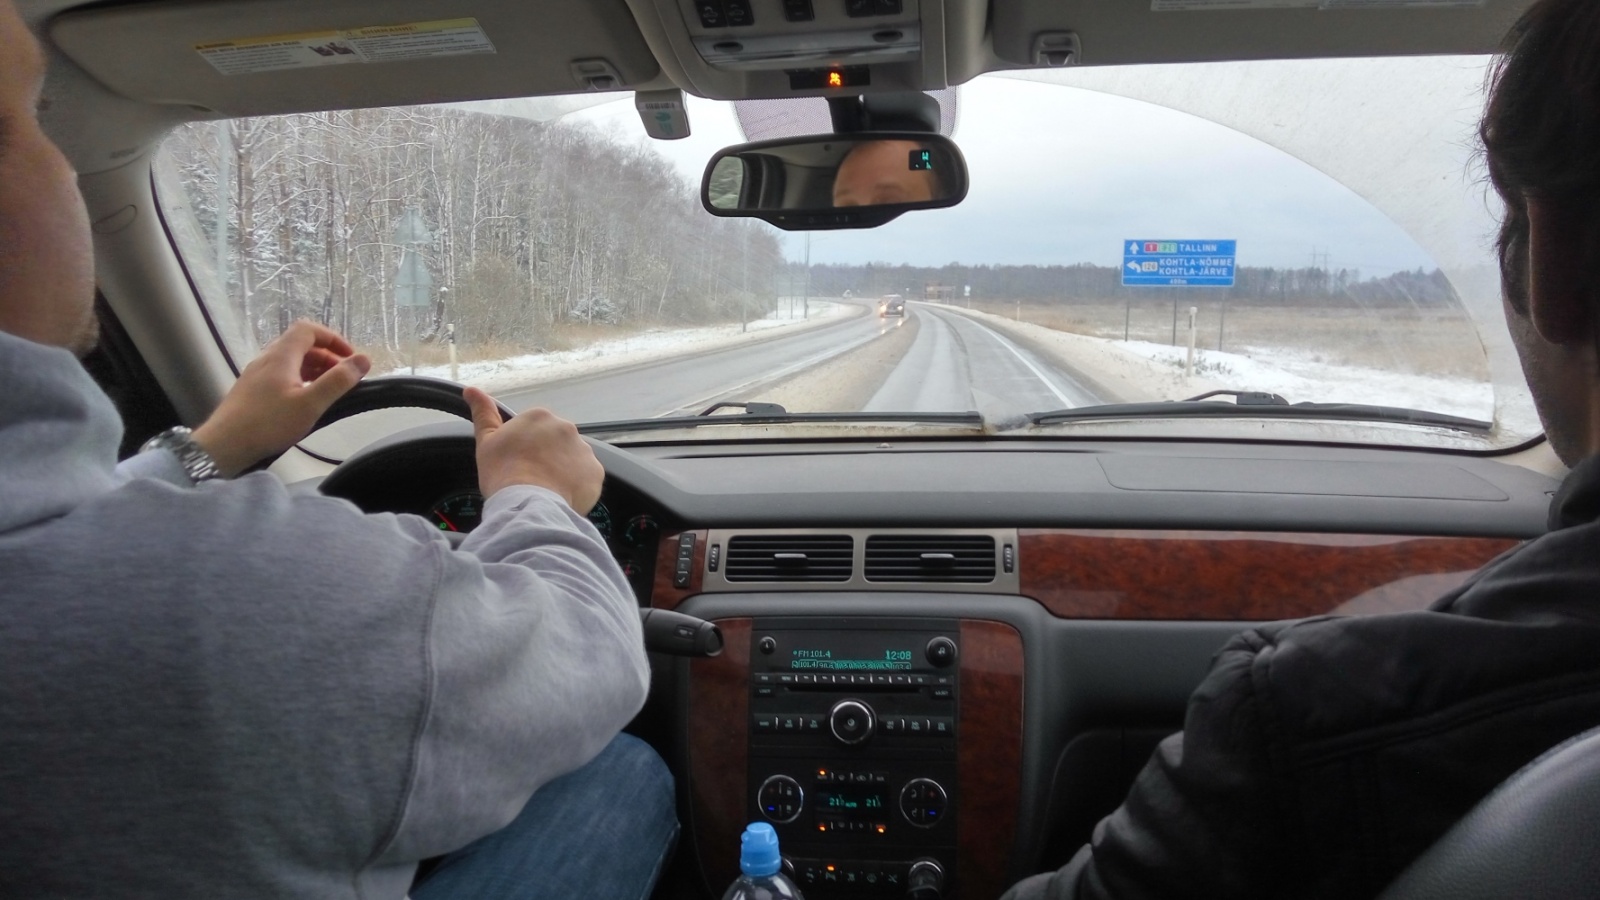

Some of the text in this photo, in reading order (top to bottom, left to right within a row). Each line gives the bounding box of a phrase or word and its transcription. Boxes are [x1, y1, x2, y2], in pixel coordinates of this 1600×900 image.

[1179, 243, 1217, 252] TALLINN
[1159, 257, 1233, 266] KOHTLA-NÕMME
[1158, 266, 1229, 276] KOHTLA-JÄRVE
[810, 649, 831, 658] 101.4
[885, 649, 912, 660] 12:08
